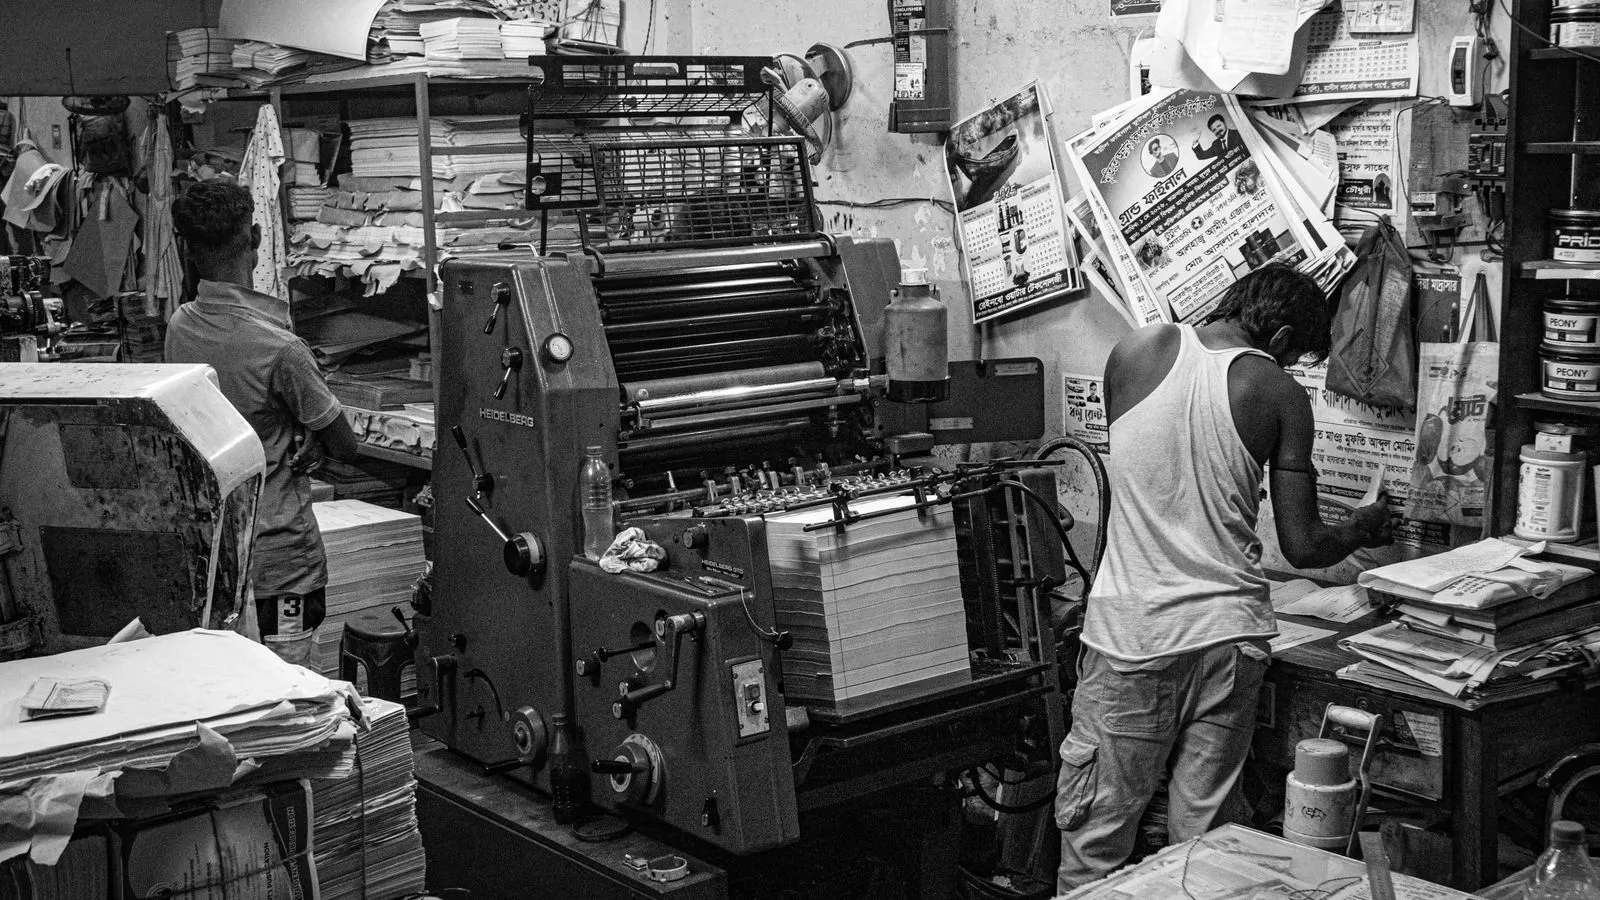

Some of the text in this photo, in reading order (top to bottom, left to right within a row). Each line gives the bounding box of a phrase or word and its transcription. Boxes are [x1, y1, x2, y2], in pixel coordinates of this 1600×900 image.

[992, 184, 1017, 203] 2025
[1119, 168, 1185, 225] গ্রান্ড ফাইনাল
[1346, 185, 1372, 194] চৌধুরী
[1176, 234, 1205, 256] আলহাজ্ব
[1205, 217, 1227, 234] আমীর
[1230, 200, 1250, 219] এজাজ
[1252, 189, 1266, 200] খান
[1185, 256, 1202, 271] মোঃ
[1204, 229, 1238, 255] আসলাম
[1241, 203, 1274, 228] হালদার
[1416, 274, 1458, 292] দিয়া মাদ্রাসার
[979, 295, 1003, 309] রেইনবো
[1005, 287, 1025, 299] ওয়াটার
[1550, 318, 1577, 328] PEONY
[1556, 368, 1588, 378] PEONY
[480, 408, 534, 427] HEIDELBERG
[1085, 407, 1106, 422] রেন্ট-
[1326, 430, 1342, 443] মাওঃ
[1344, 432, 1366, 446] মুফতি
[1368, 437, 1391, 452] আব্দুল
[1326, 455, 1346, 466] হযরত
[702, 560, 732, 571] HEIDELBERG
[284, 597, 300, 617] 3
